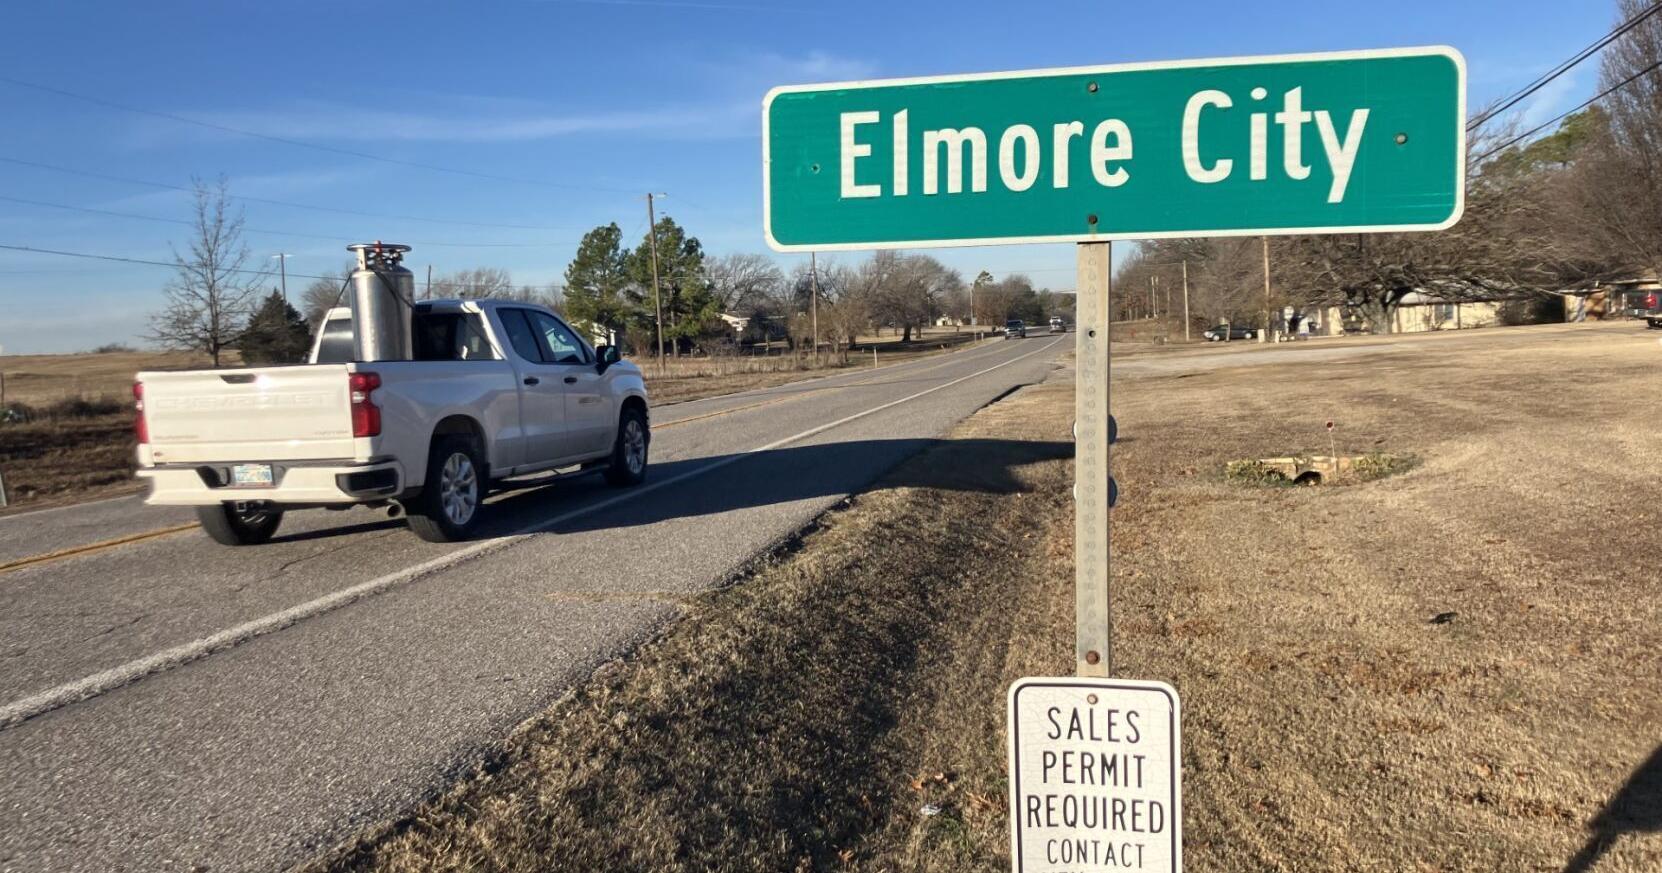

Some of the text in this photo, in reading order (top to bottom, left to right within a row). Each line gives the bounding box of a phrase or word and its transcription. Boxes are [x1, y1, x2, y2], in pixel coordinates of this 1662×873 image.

[840, 86, 1370, 204] Elmore City
[1047, 706, 1141, 744] SALES
[1042, 750, 1146, 788] PERMIT
[1026, 794, 1165, 834] REQUIRED
[1046, 838, 1145, 869] CONTACT
